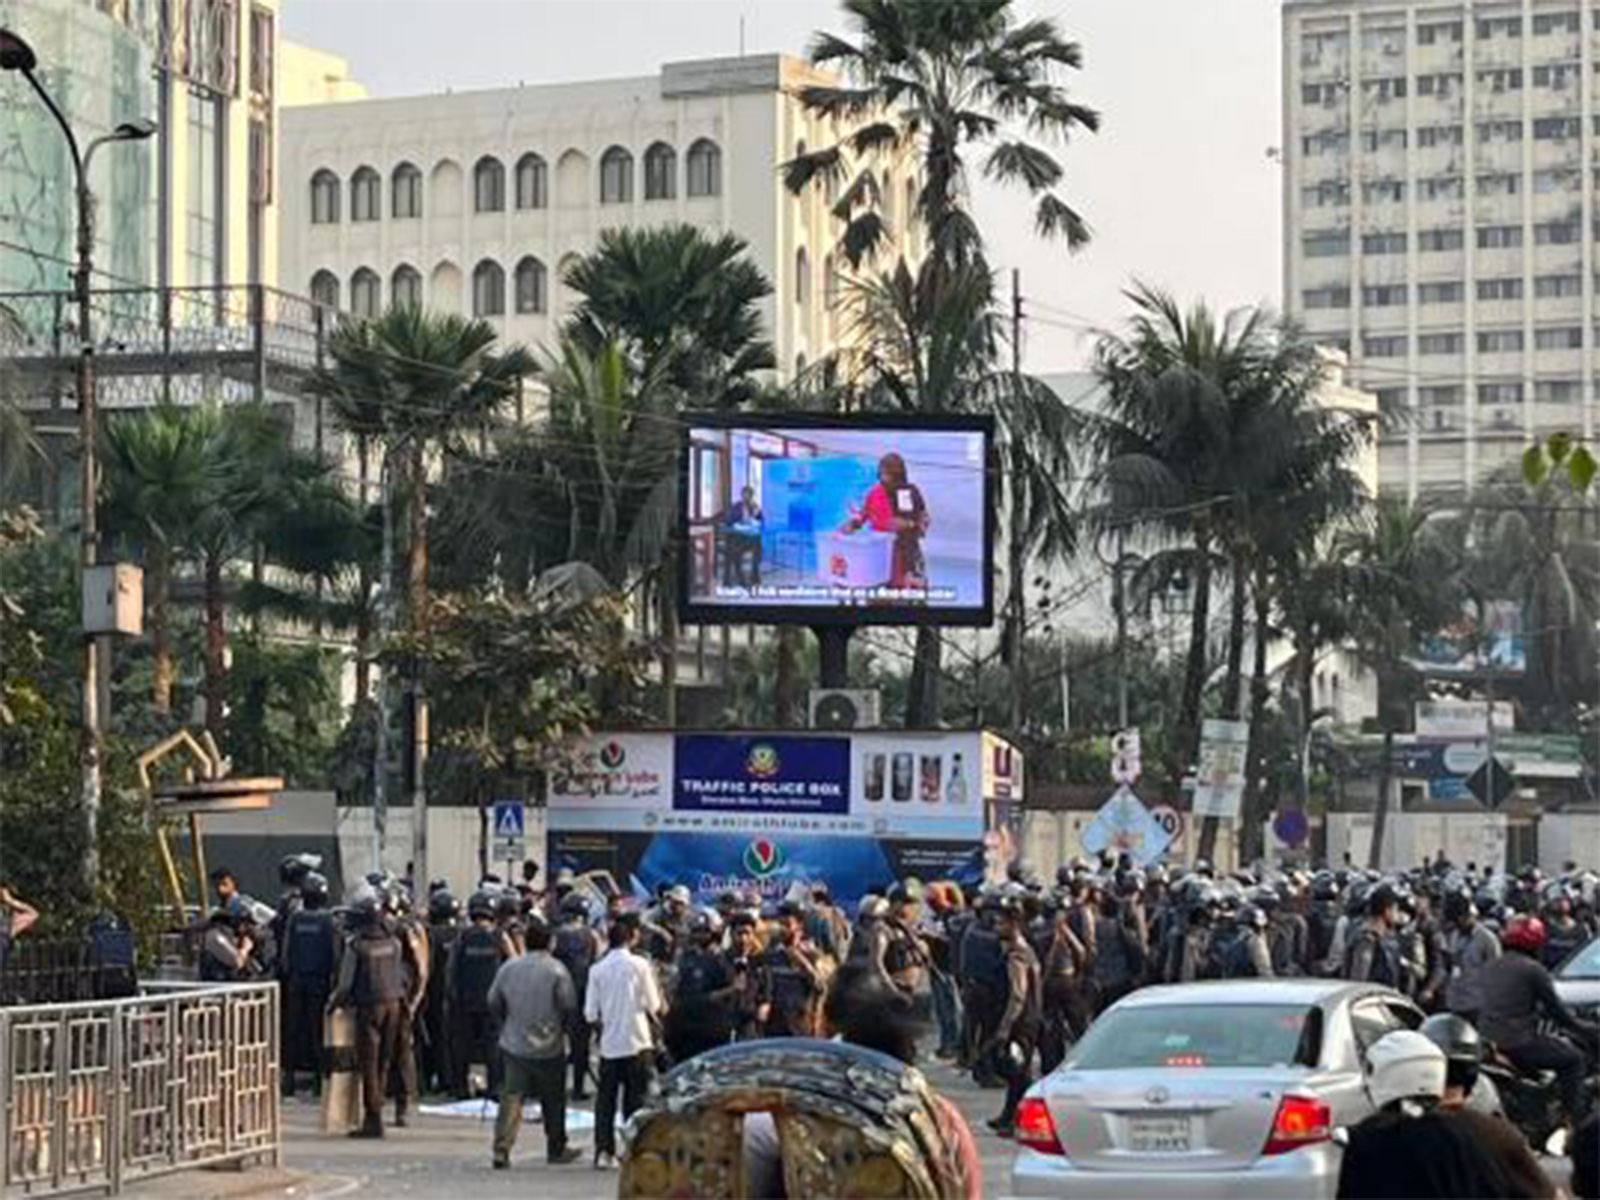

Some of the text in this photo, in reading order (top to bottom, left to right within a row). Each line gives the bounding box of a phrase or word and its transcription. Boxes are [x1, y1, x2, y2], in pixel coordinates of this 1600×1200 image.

[682, 780, 841, 796] TRAFFIC POLICE BOX
